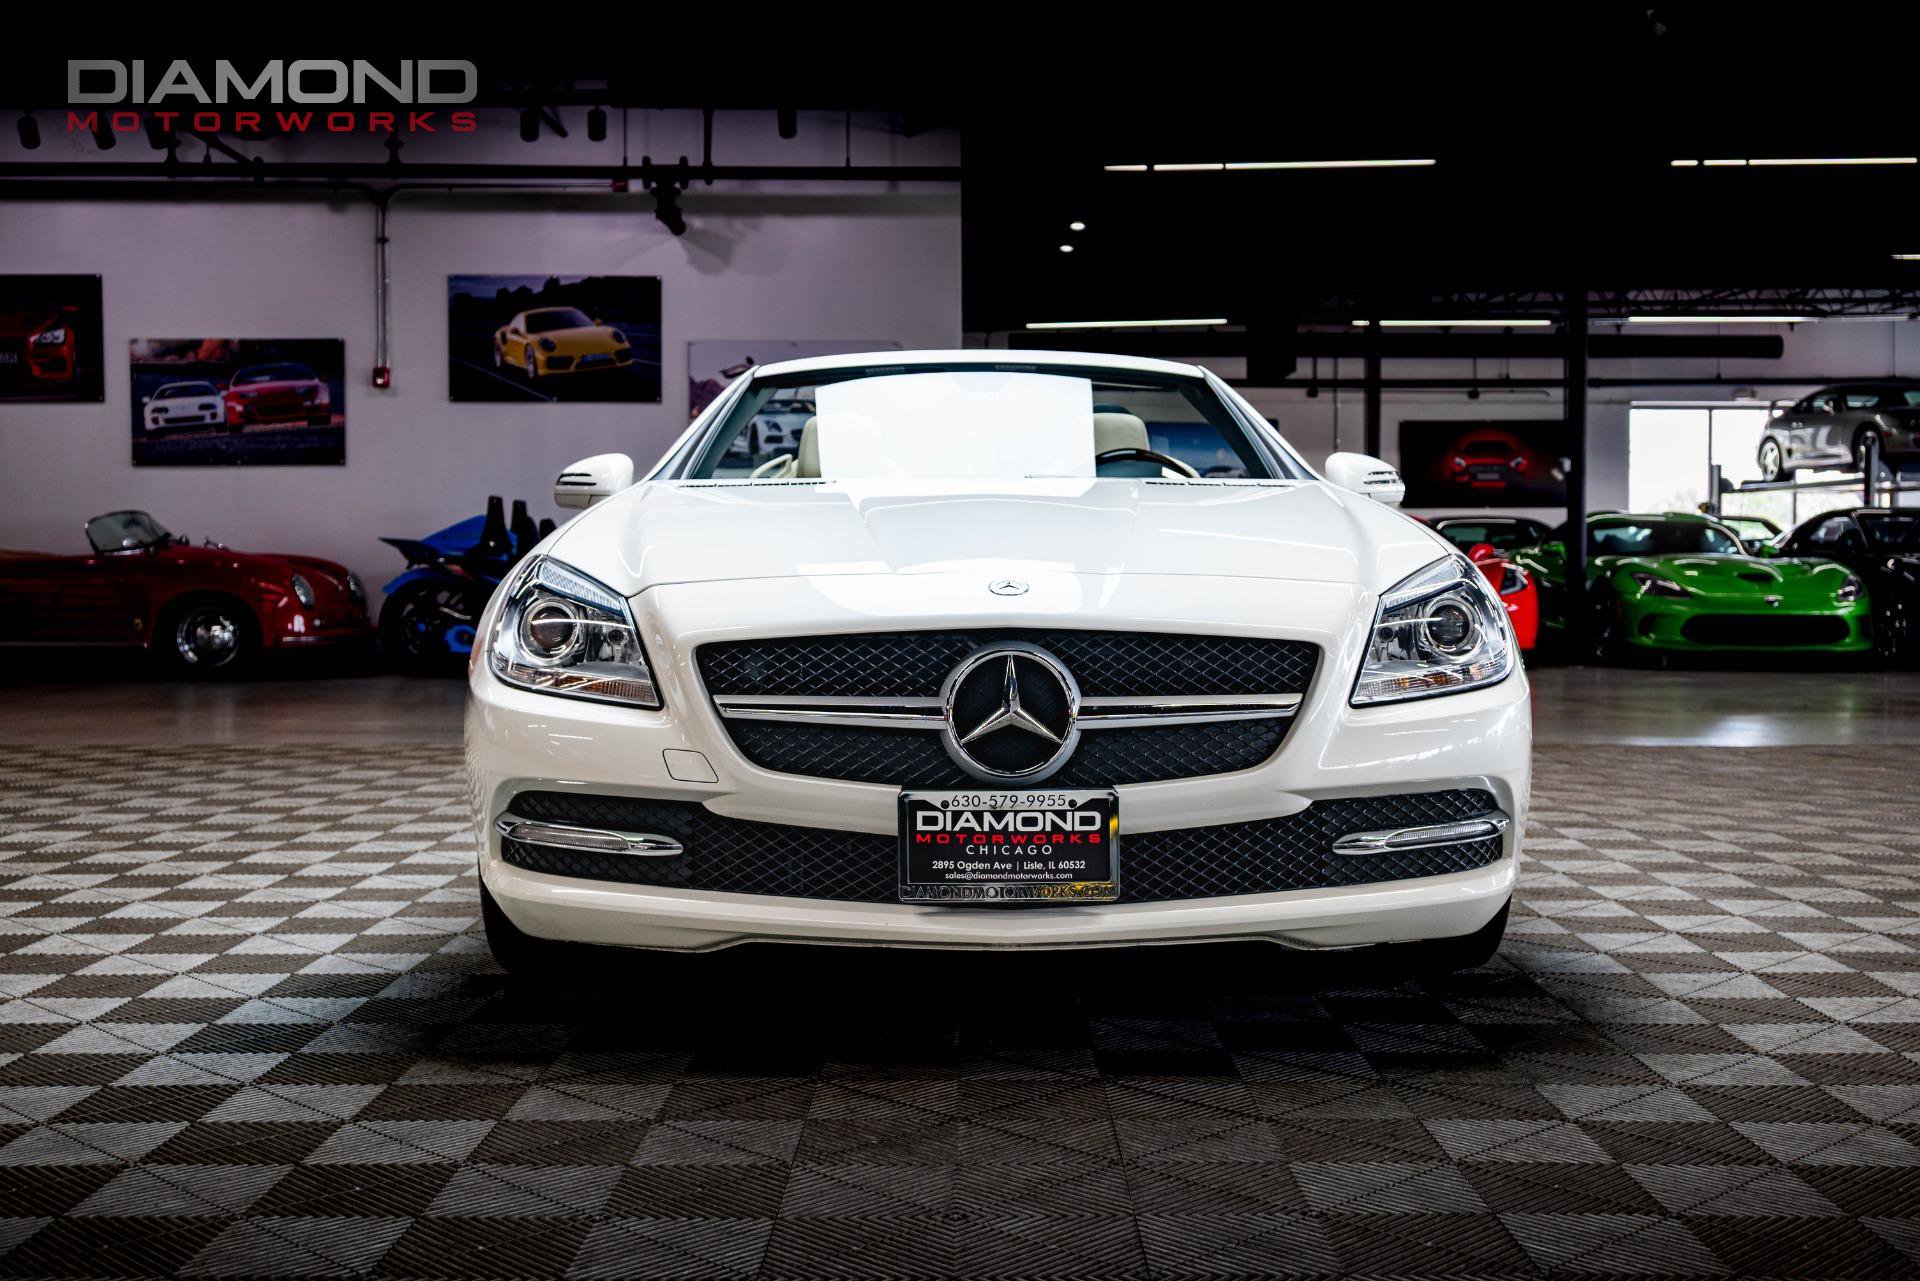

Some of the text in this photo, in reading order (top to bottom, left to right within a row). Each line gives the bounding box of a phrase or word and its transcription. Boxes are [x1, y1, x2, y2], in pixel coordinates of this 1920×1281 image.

[951, 794, 1067, 809] 630-579-9955
[916, 811, 1102, 832] DIAMOND
[916, 833, 1102, 845] MOTORWORKS
[966, 845, 1053, 855] CHICAGO
[932, 860, 955, 870] 2895
[957, 860, 991, 872] Ogden
[993, 861, 1013, 870] Ave
[1023, 861, 1046, 871] Lisle,
[1048, 861, 1056, 870] IL
[1058, 860, 1086, 870] 60532
[945, 871, 1074, 881] sales@diamondmotorworks.com
